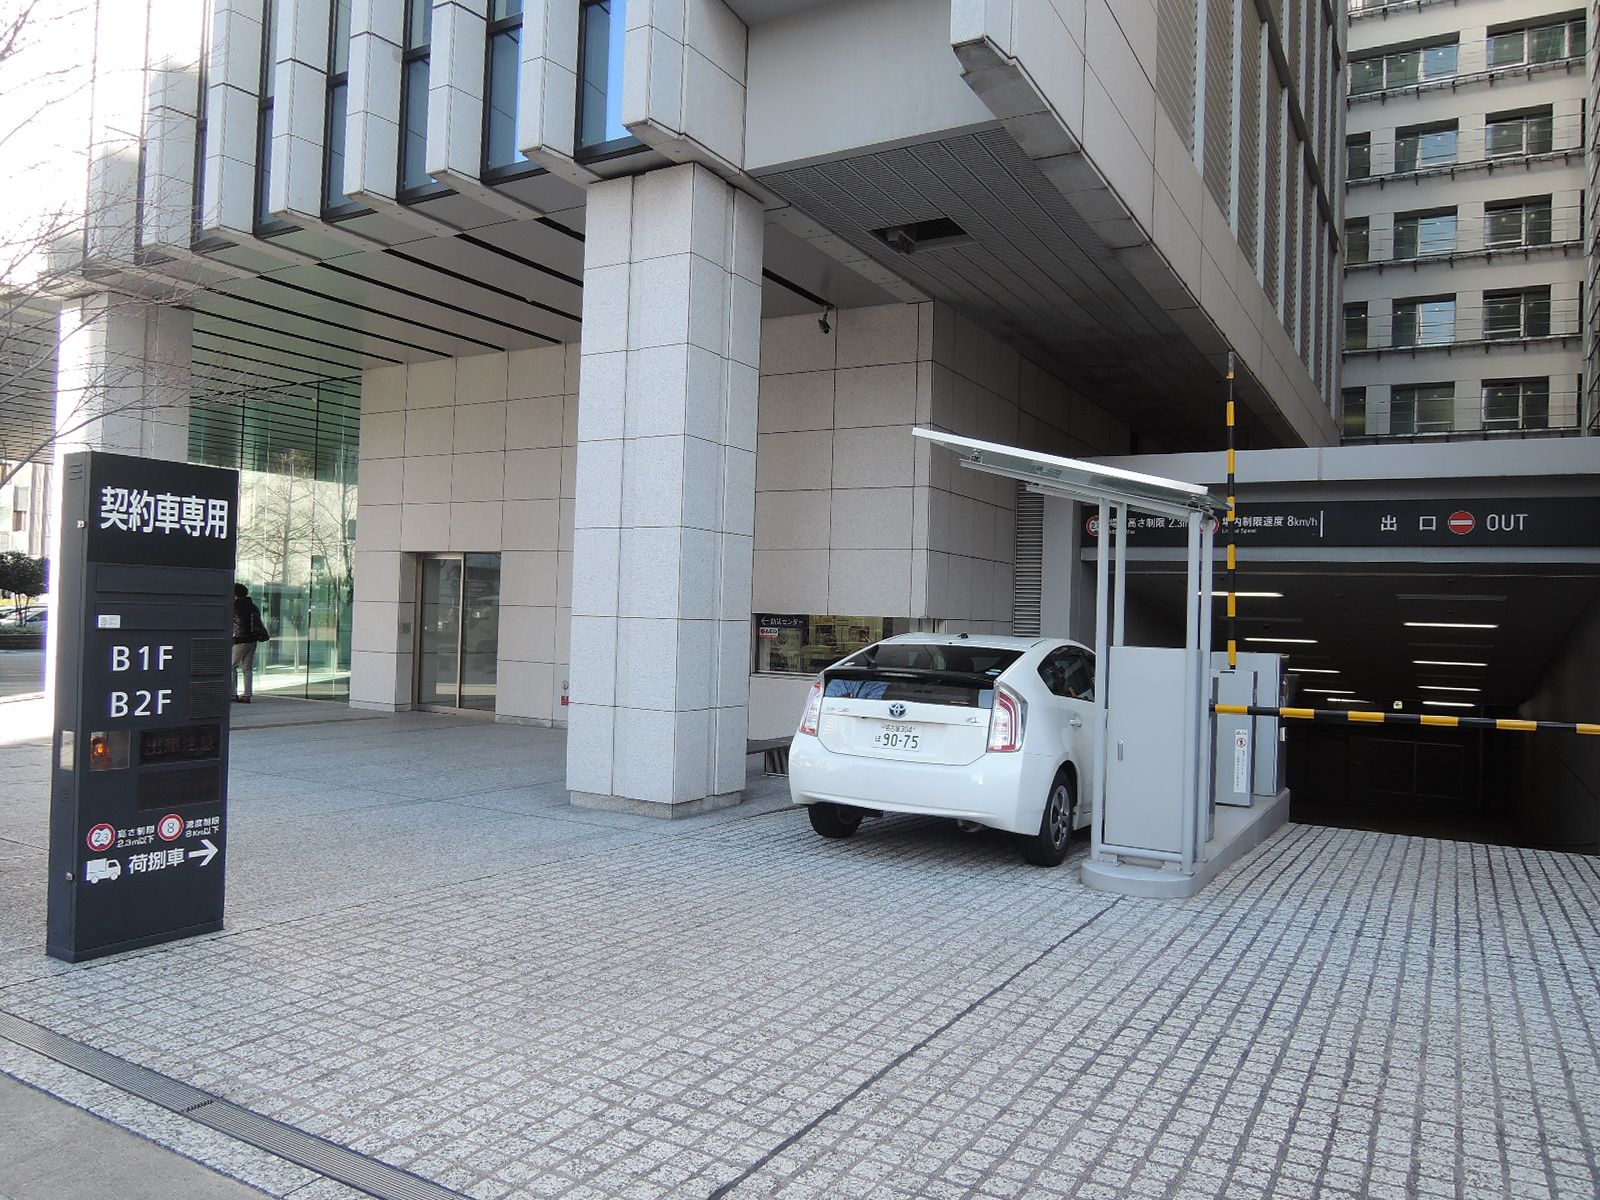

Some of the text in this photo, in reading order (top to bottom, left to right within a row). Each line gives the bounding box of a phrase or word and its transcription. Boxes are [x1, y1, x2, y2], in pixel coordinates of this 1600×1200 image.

[100, 485, 229, 540] 契約車専用
[1287, 515, 1318, 527] 8km/h
[1486, 513, 1529, 532] OUT
[882, 733, 919, 749] 90-75
[117, 825, 155, 839] 高さ制限
[166, 822, 175, 834] 8
[128, 848, 185, 875] 荷捌車
